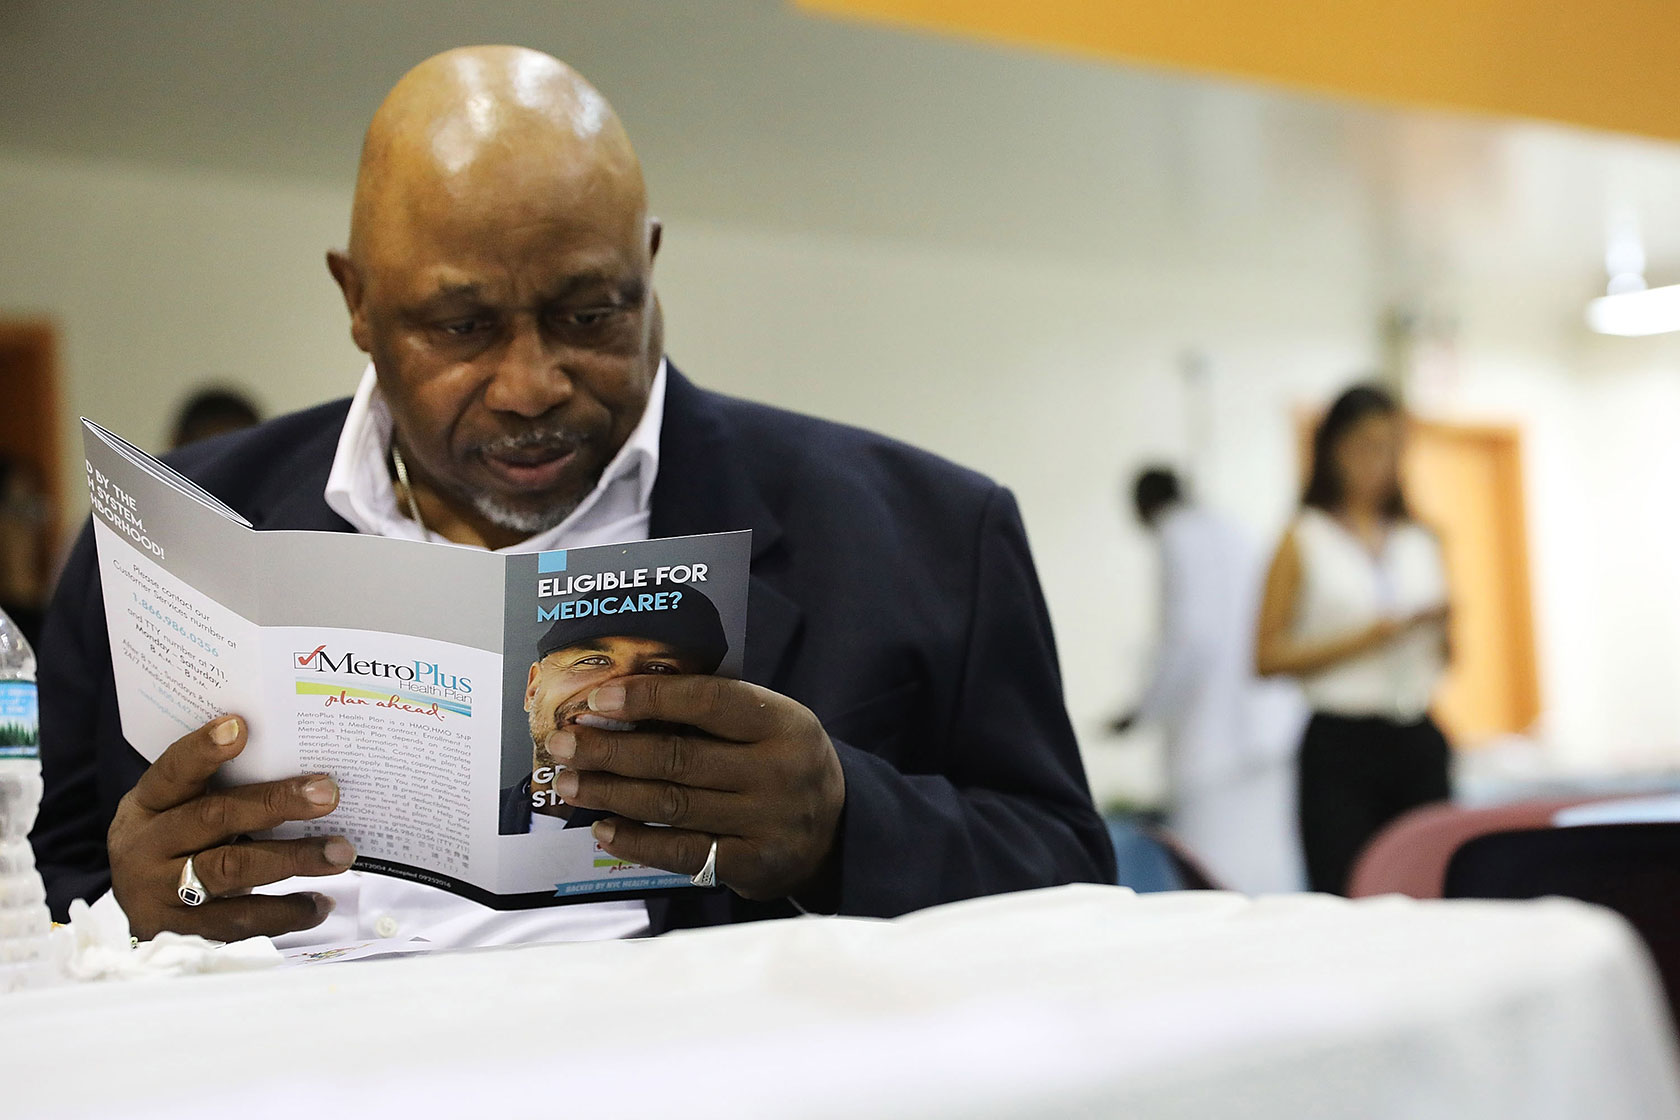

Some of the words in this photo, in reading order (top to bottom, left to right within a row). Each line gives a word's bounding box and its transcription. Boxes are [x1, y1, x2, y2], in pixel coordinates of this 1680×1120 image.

[96, 470, 109, 488] BY
[112, 484, 137, 512] THE
[98, 486, 147, 533] SYSTEM.
[133, 564, 159, 589] Please
[162, 587, 192, 610] contact
[195, 609, 210, 621] our
[538, 568, 648, 598] ELIGIBLE
[656, 563, 708, 586] FOR
[113, 559, 151, 593] Customer
[154, 590, 188, 619] Services
[190, 616, 224, 641] number
[228, 640, 236, 648] at
[536, 591, 682, 623] MEDICARE?
[128, 608, 143, 623] and
[144, 619, 160, 635] TTY
[164, 634, 196, 660] number
[198, 659, 206, 668] at
[136, 624, 170, 654] Monday
[184, 668, 190, 678] 8
[318, 651, 472, 693] MetroPlus
[324, 690, 370, 707] plan
[400, 680, 442, 697] Health
[444, 688, 472, 704] Plan
[348, 721, 383, 730] Medicare
[422, 732, 460, 745] Enrollment
[456, 732, 472, 741] SNP
[356, 738, 398, 748] information
[438, 751, 472, 764] complete
[392, 735, 424, 745] depends
[442, 746, 472, 756] contract
[392, 748, 421, 758] Contact
[441, 760, 456, 768] plan
[338, 778, 372, 786] Medicare
[431, 780, 456, 790] change
[456, 771, 470, 780] and
[411, 797, 450, 810] deductibles
[415, 804, 432, 813] Extra
[437, 810, 454, 819] Help
[606, 880, 620, 889] NYC
[622, 879, 649, 888] HEALTH
